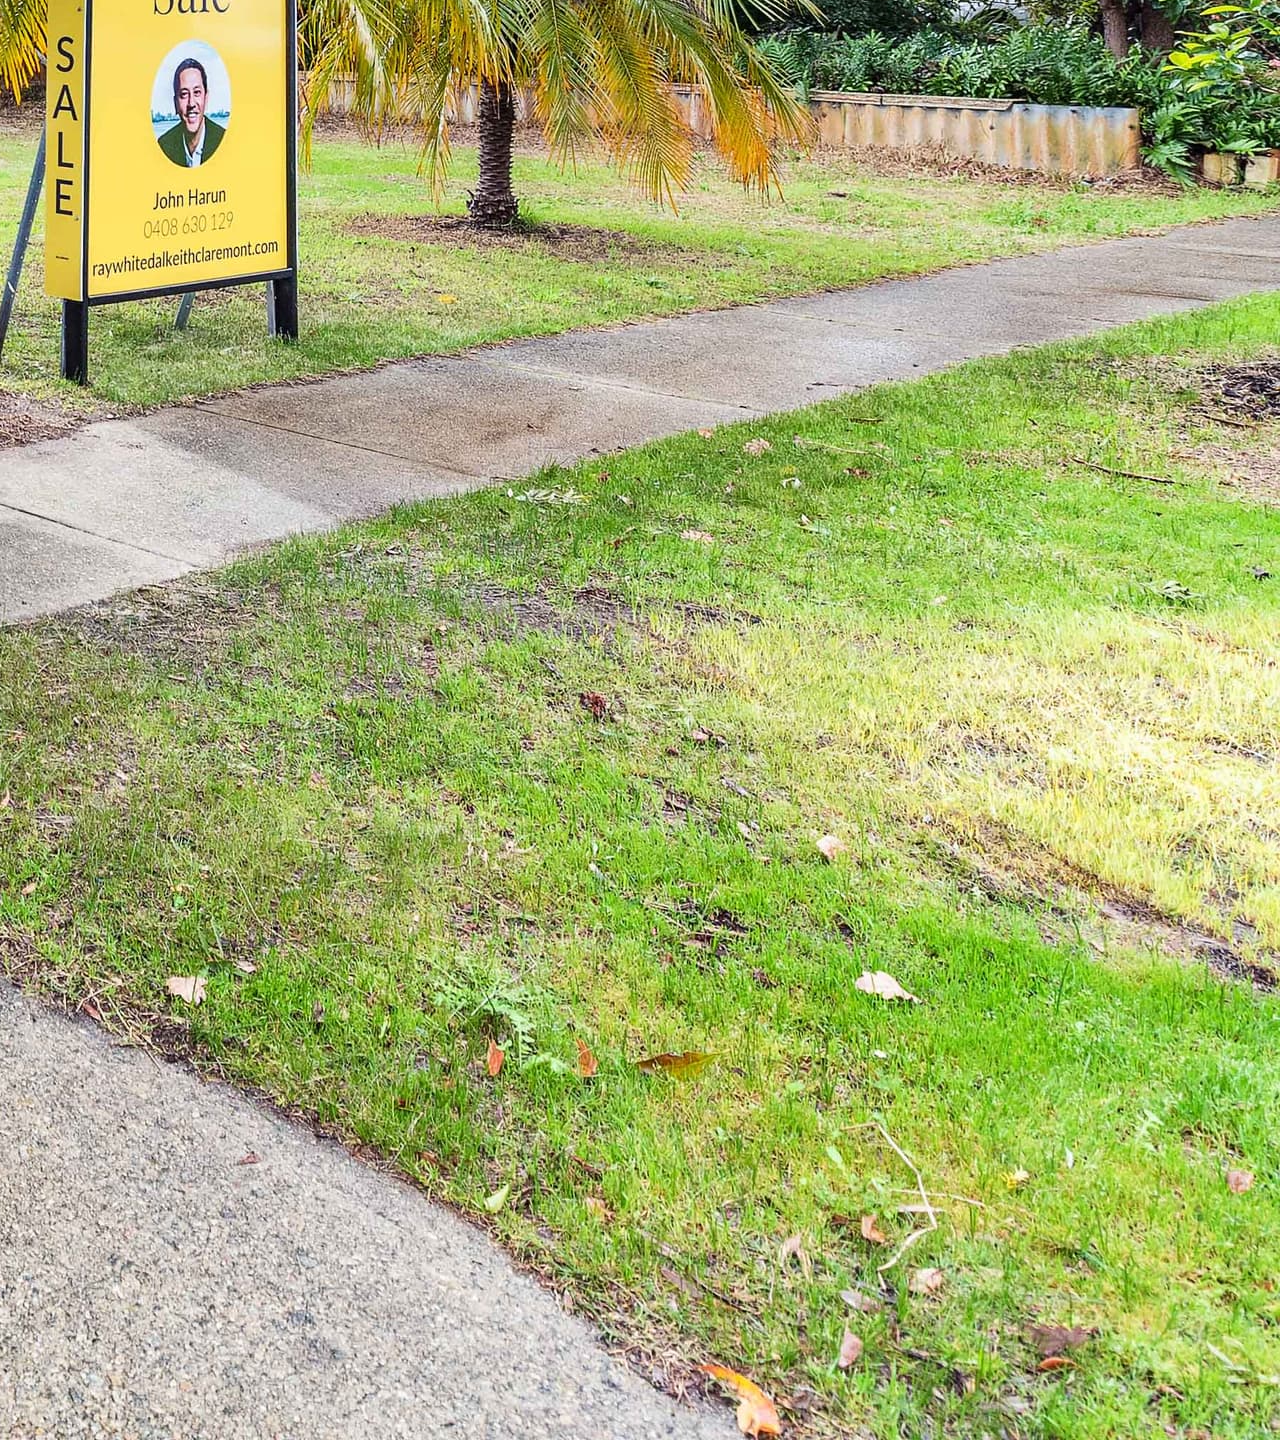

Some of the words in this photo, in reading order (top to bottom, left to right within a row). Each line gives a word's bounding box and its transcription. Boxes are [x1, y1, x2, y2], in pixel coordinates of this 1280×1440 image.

[52, 36, 78, 216] SALE
[153, 190, 184, 211] John
[188, 188, 226, 206] Harun
[143, 218, 178, 239] 0408
[182, 215, 207, 234] 630
[212, 211, 234, 231] 129
[92, 241, 278, 278] raywhitedalkeithclaremont.com
